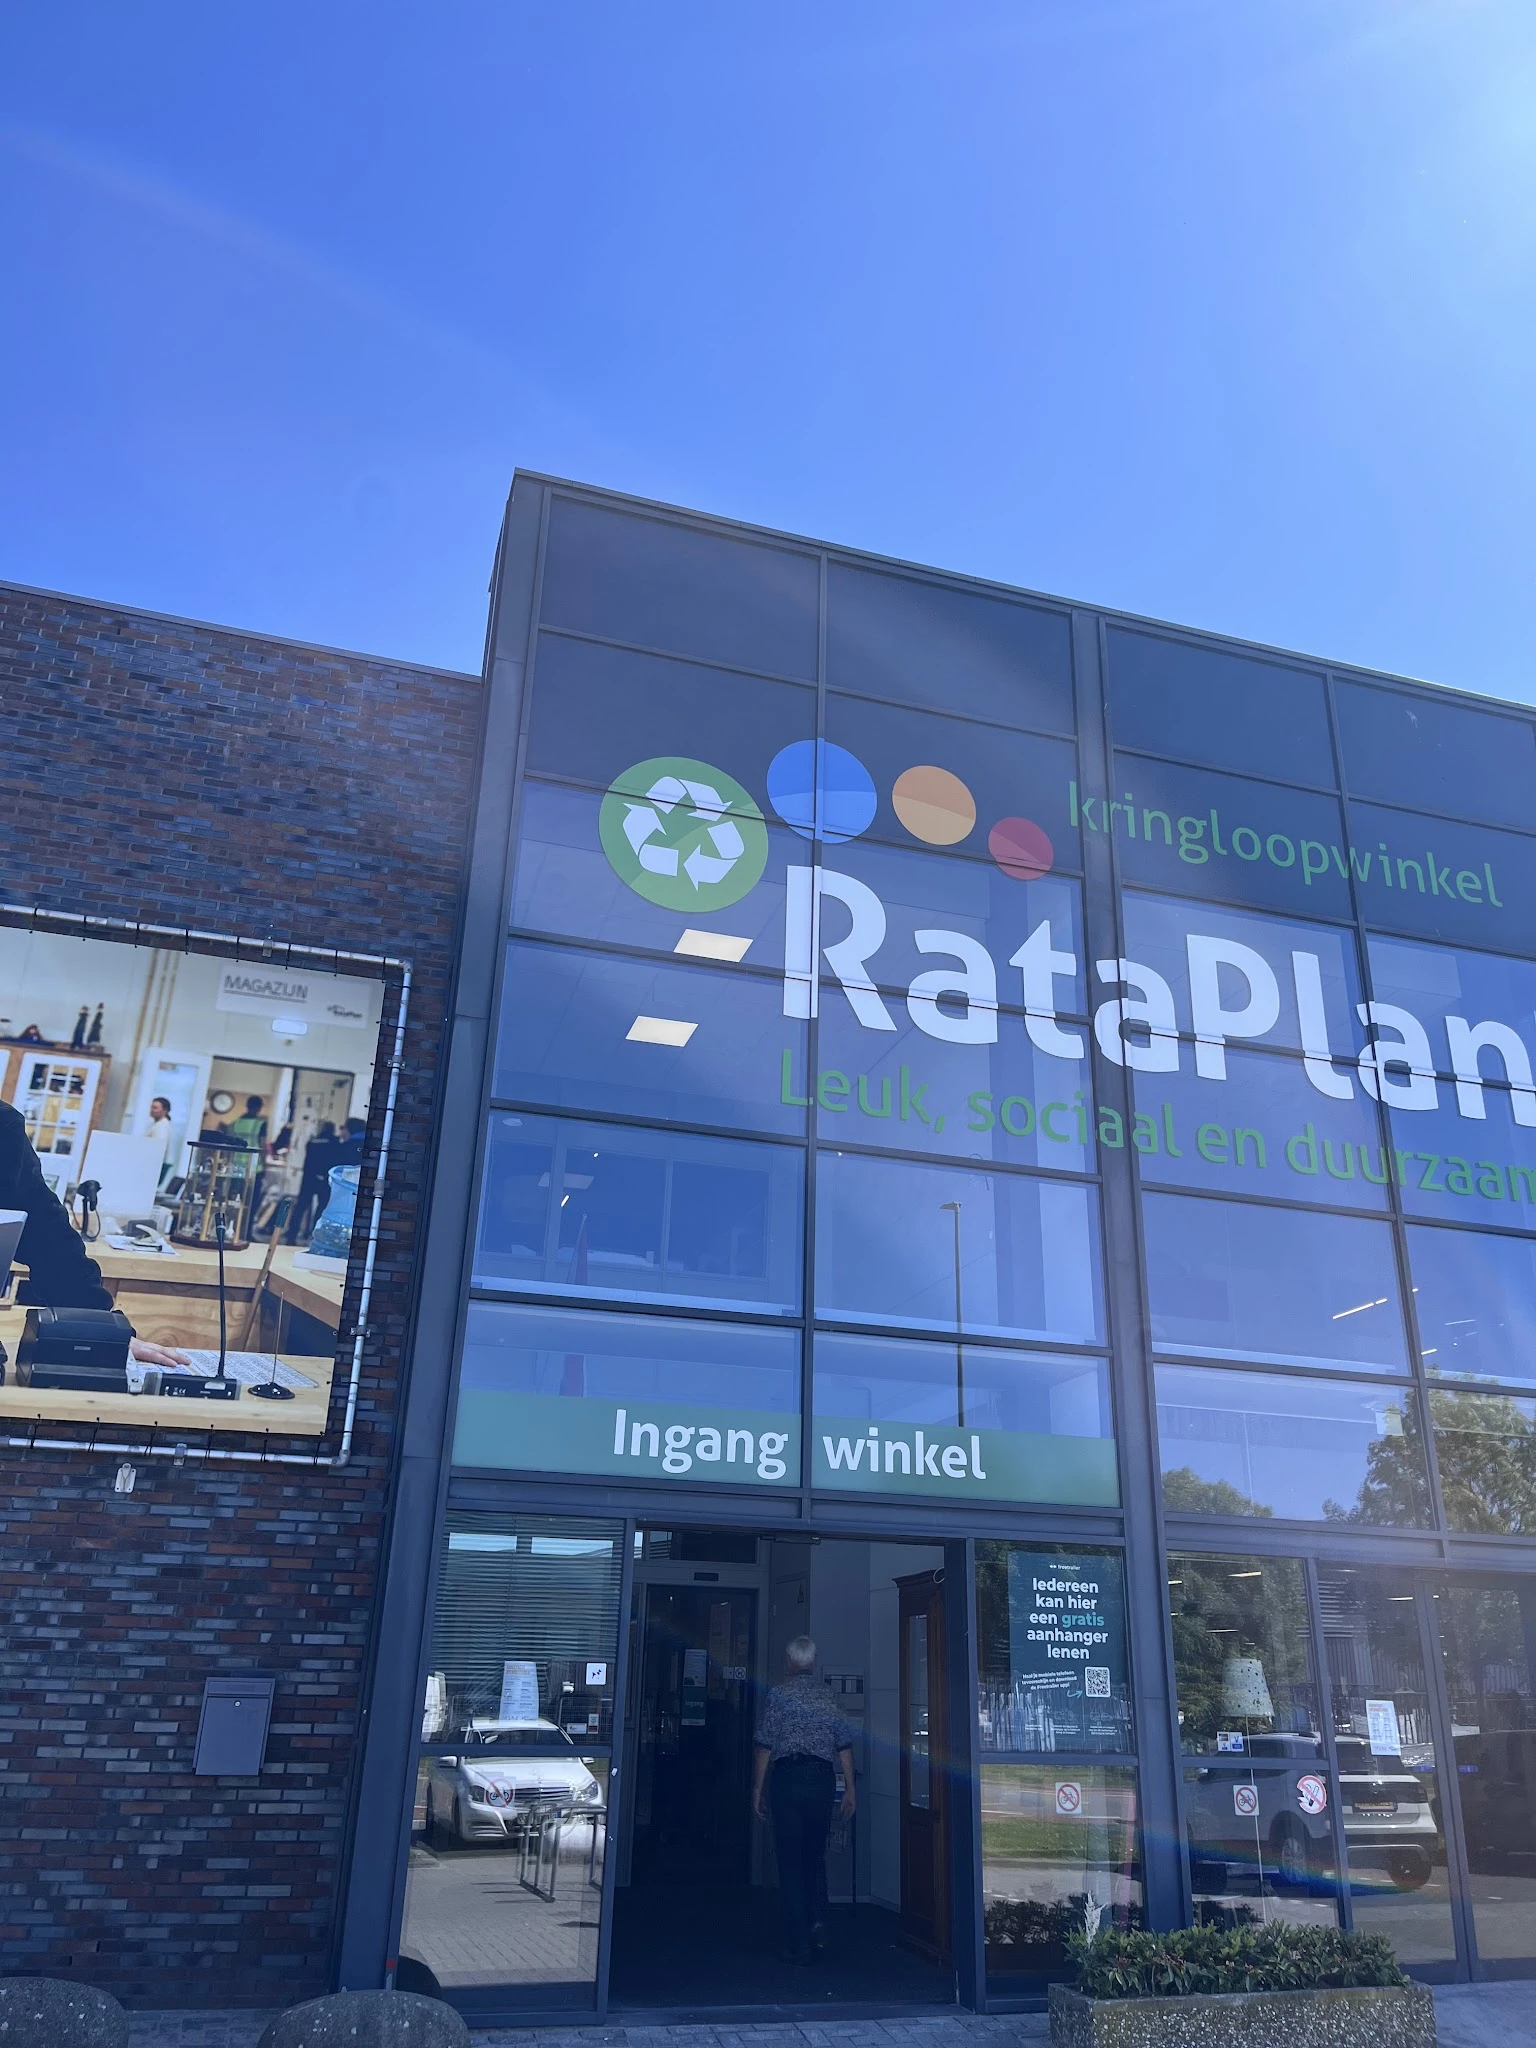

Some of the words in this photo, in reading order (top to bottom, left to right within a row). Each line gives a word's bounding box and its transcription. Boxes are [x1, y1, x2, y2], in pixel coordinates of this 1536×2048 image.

[1069, 781, 1504, 908] kringloopwinkel
[783, 864, 1536, 1128] RataPlan
[781, 1049, 946, 1134] Leuk,
[967, 1089, 1183, 1157] sociaal
[1196, 1120, 1267, 1169] en
[613, 1409, 789, 1479] Ingang
[822, 1427, 987, 1480] winkel
[1032, 1577, 1099, 1594] Iedereen
[1035, 1593, 1064, 1609] kan
[1067, 1595, 1097, 1610] hier
[1029, 1611, 1058, 1625] een
[1061, 1612, 1105, 1628] gratis
[1026, 1627, 1109, 1645] aanhanger
[1047, 1644, 1090, 1660] lenen
